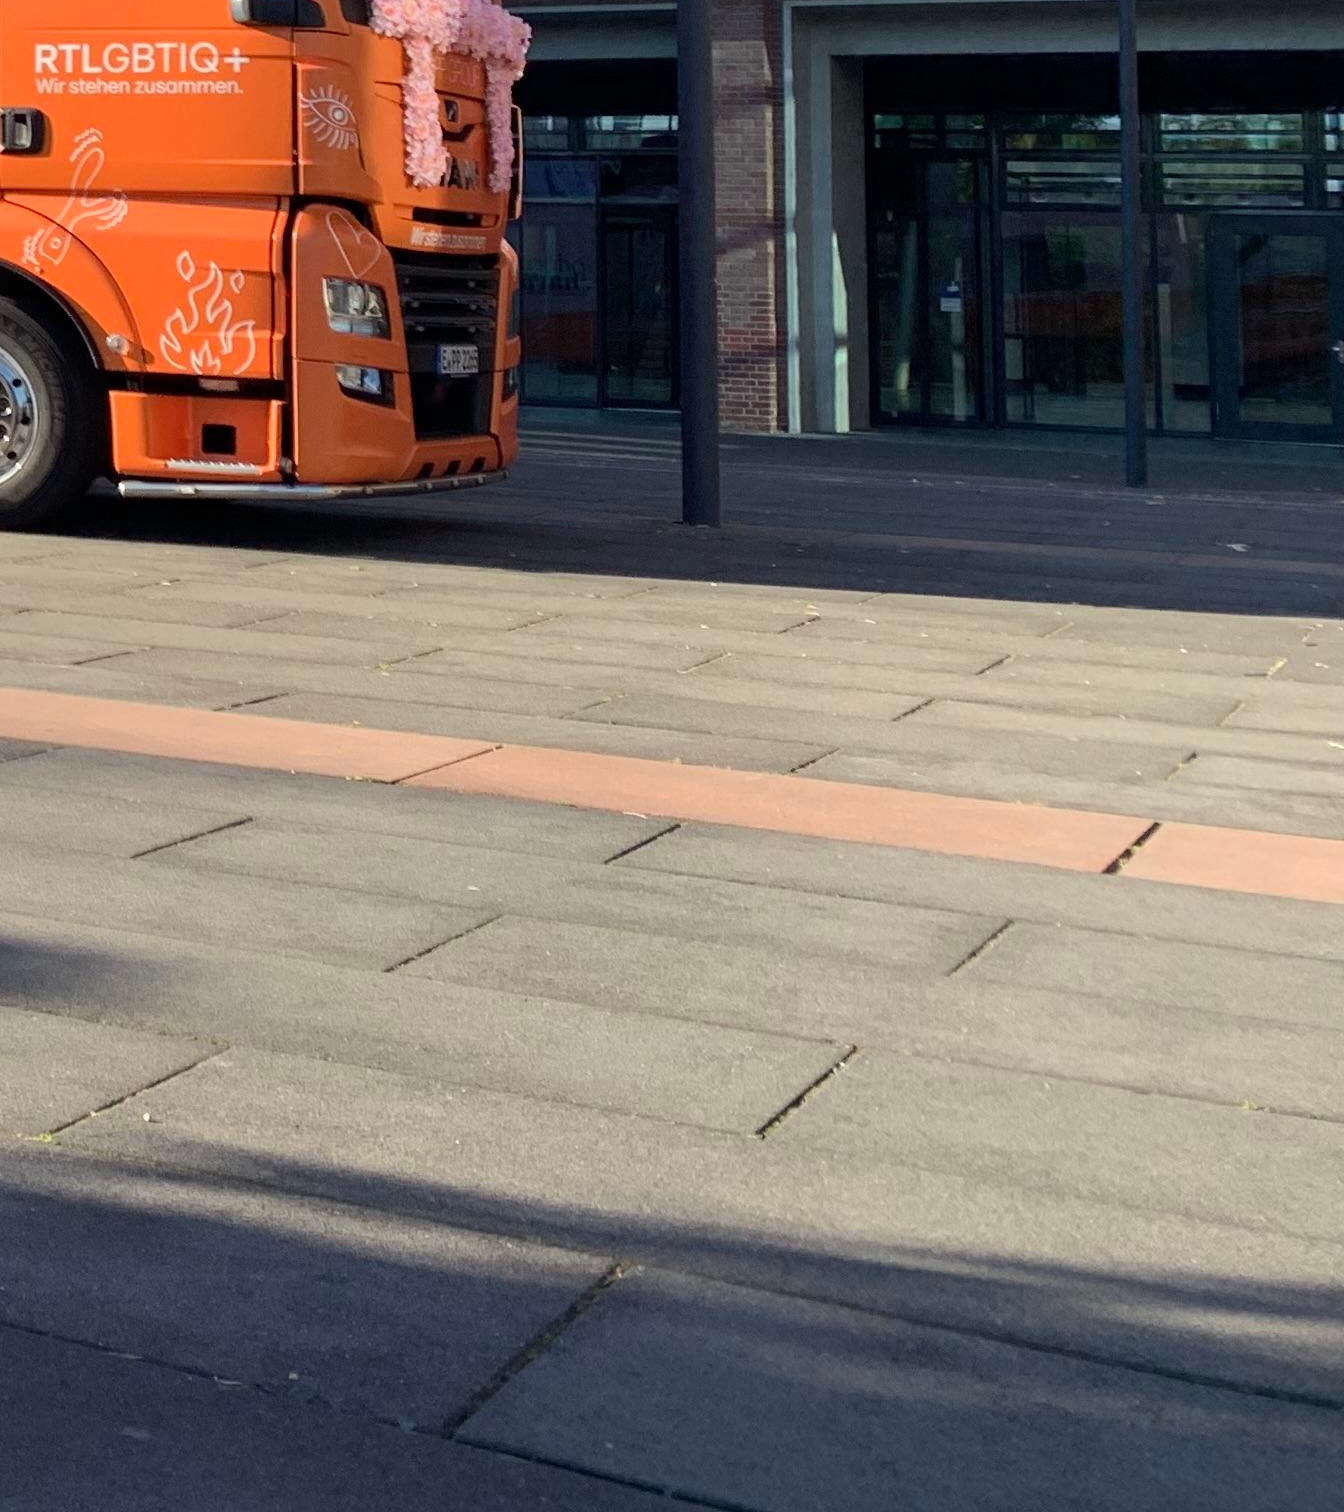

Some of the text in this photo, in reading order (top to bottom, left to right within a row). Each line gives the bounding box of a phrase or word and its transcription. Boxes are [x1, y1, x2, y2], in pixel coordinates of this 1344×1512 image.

[34, 42, 251, 74] RTLGBTIQ+
[35, 78, 244, 95] Wir stehen zusammen.
